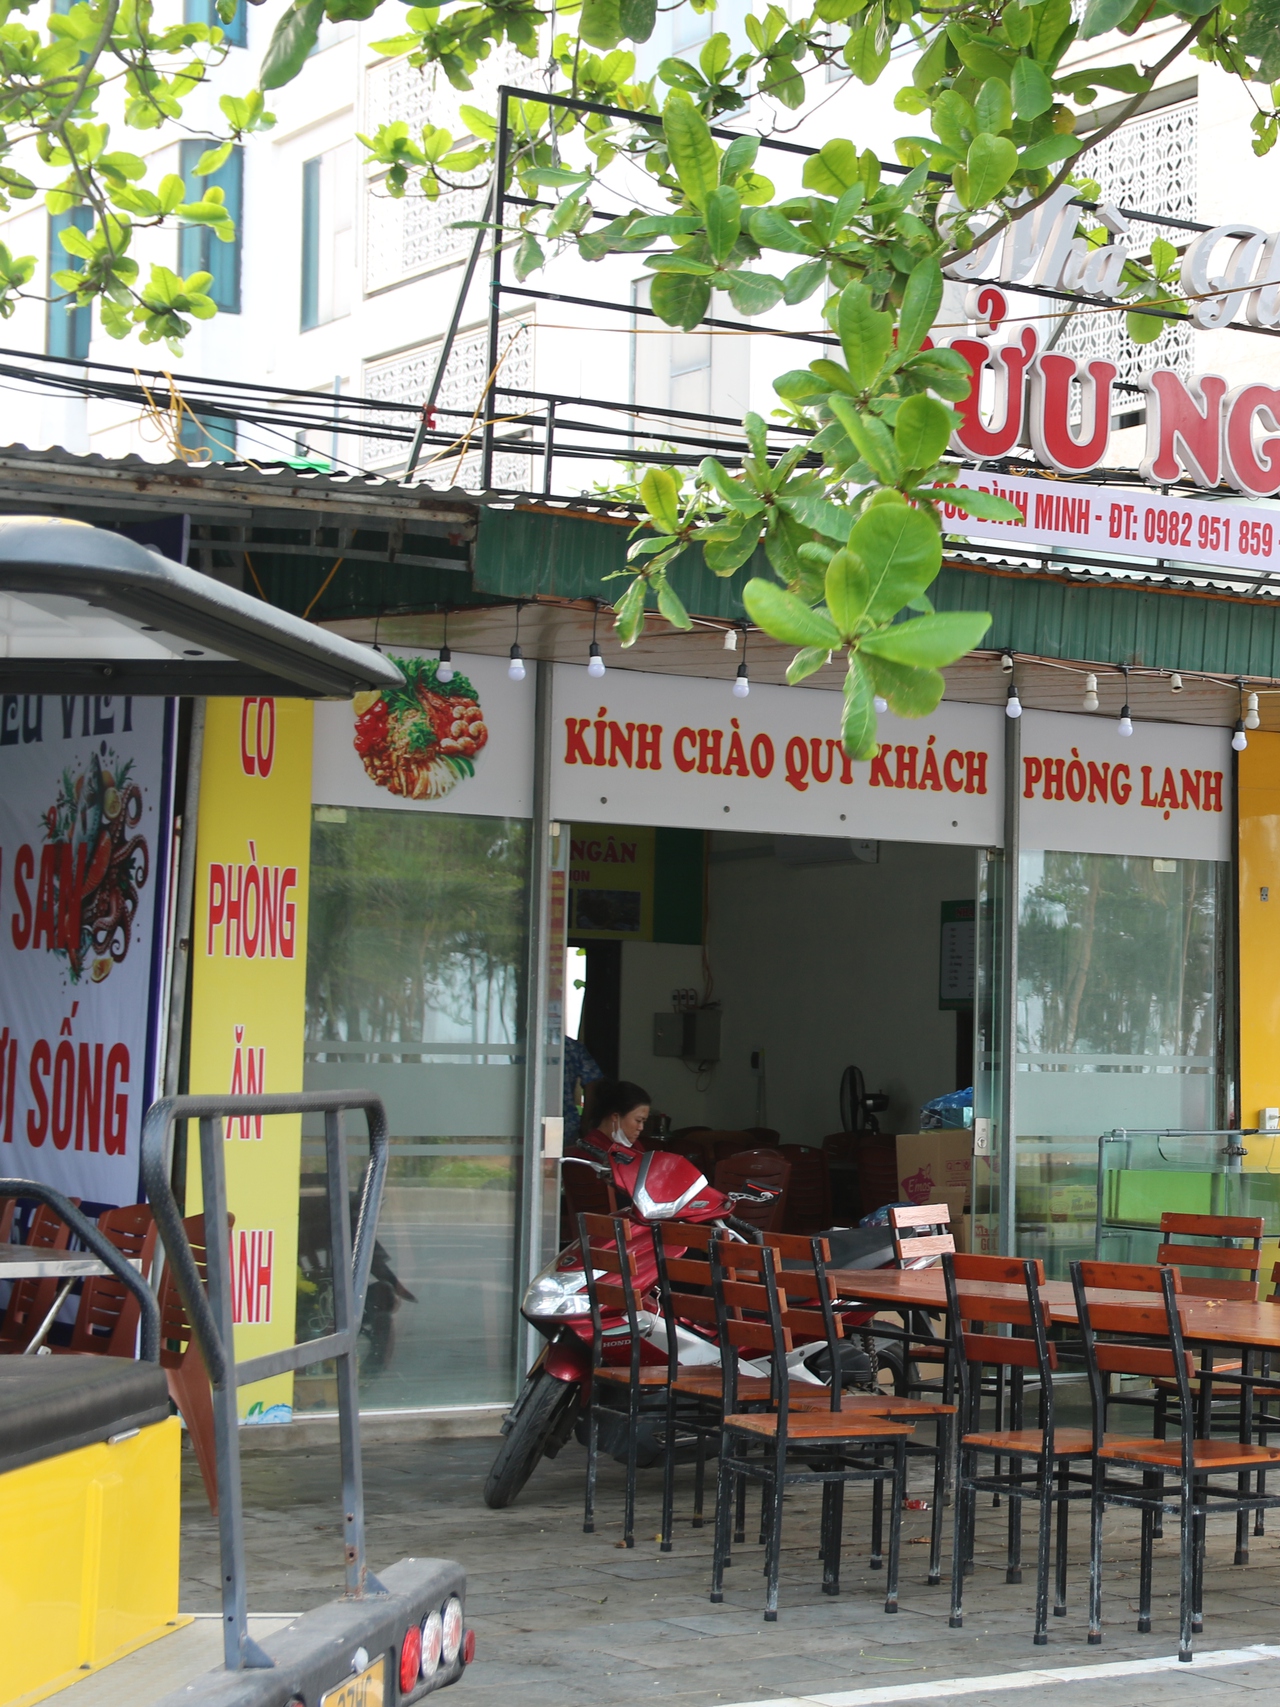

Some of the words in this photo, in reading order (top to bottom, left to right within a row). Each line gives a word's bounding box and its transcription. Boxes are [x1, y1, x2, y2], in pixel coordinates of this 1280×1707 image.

[892, 284, 1120, 475] ỬU
[1034, 493, 1091, 535] MINH
[1109, 503, 1138, 541] ĐT:
[1144, 507, 1192, 547] 0982
[1199, 514, 1231, 552] 951
[1238, 519, 1273, 557] 859
[564, 707, 663, 770] KÍNH
[673, 718, 775, 778] CHÀO
[869, 735, 988, 795] KHÁCH
[1023, 747, 1132, 806] PHÒNG
[1140, 766, 1223, 821] LẠNH
[12, 806, 87, 950] SẢN
[207, 840, 297, 958] PHÒNG
[27, 1001, 130, 1155] SỐNG
[225, 1025, 265, 1140] ĂN
[603, 1339, 632, 1348] HOND
